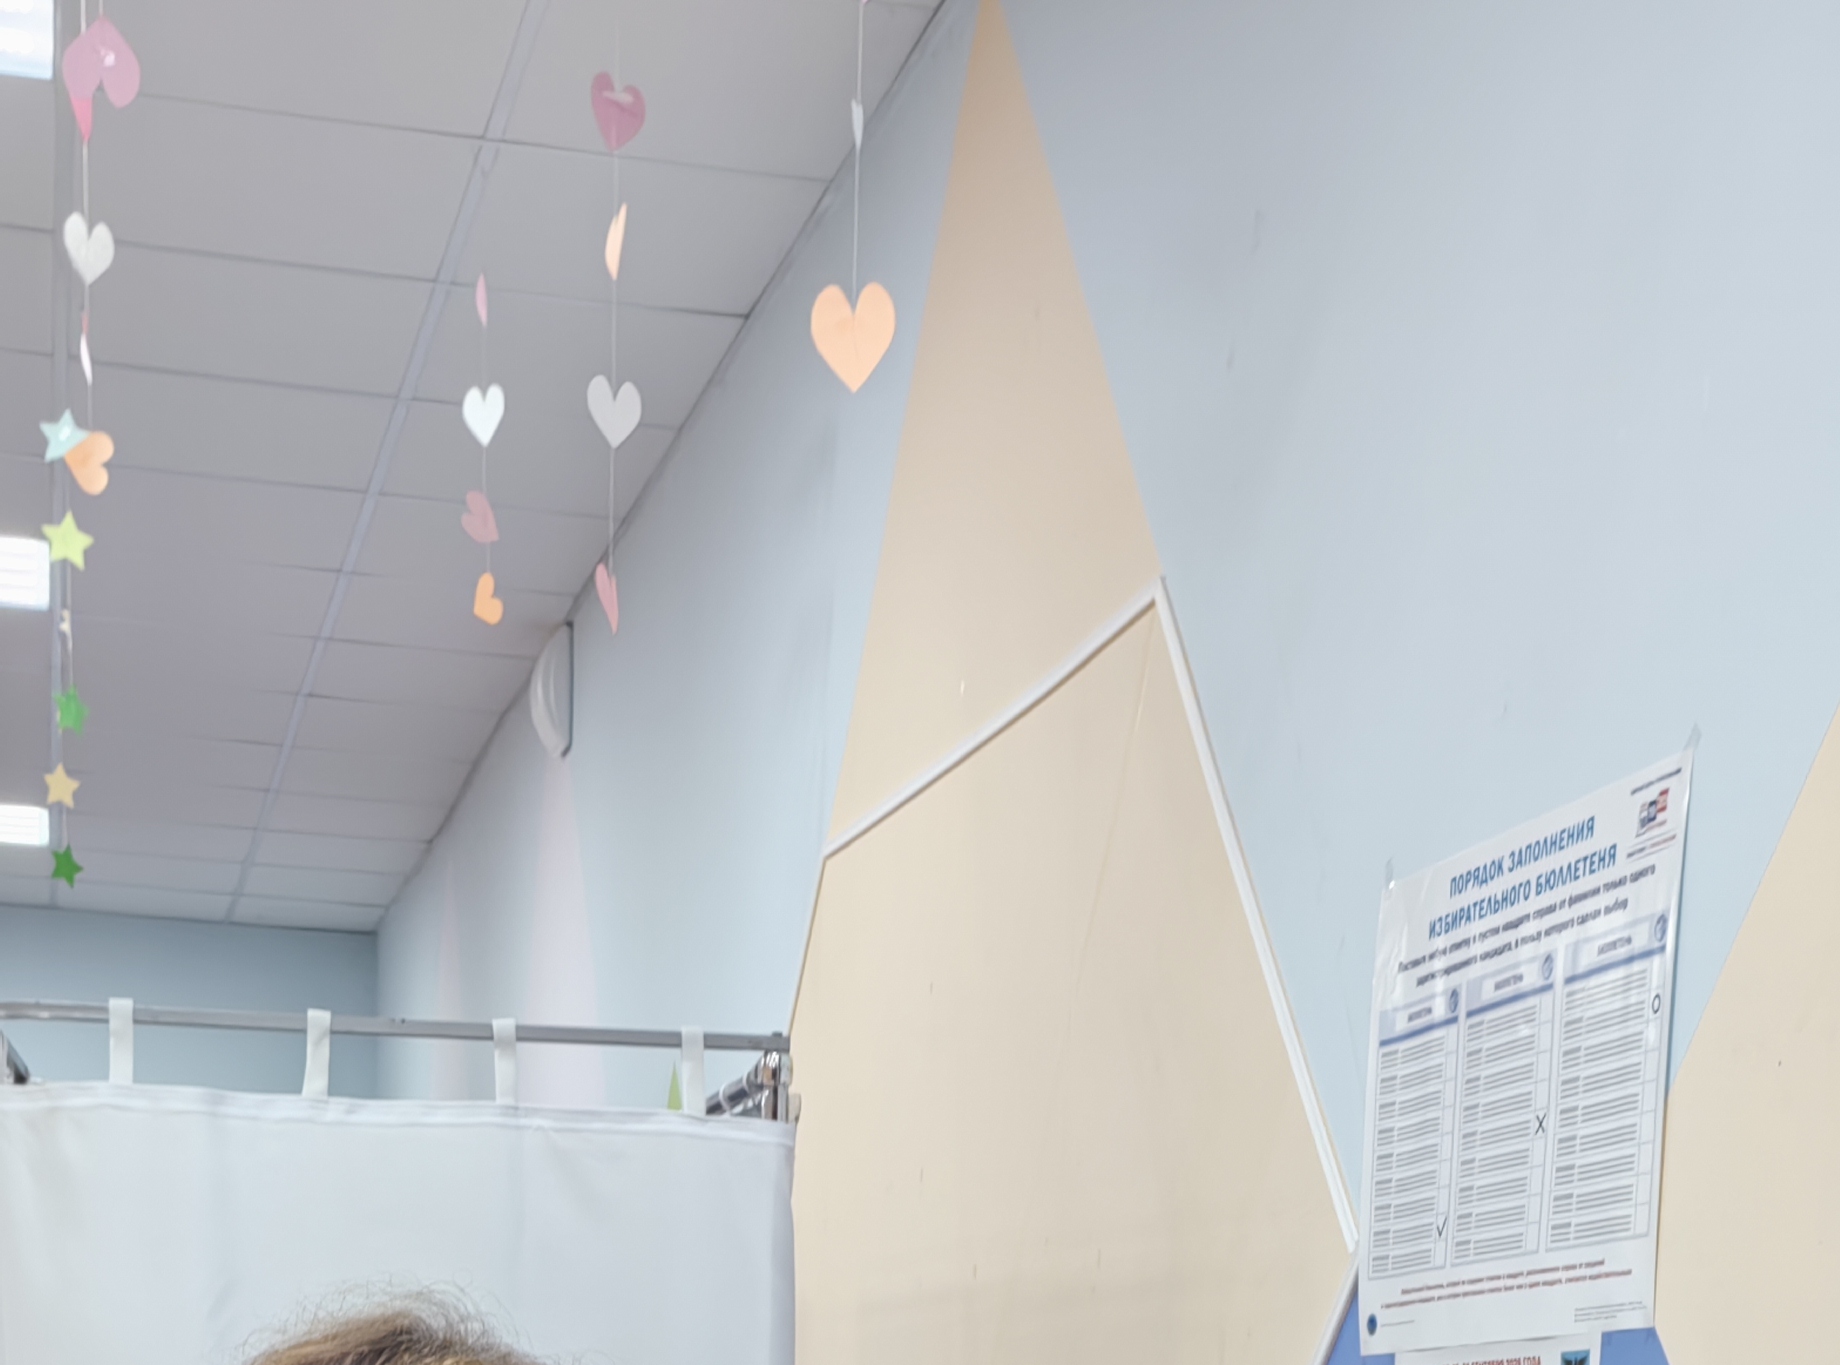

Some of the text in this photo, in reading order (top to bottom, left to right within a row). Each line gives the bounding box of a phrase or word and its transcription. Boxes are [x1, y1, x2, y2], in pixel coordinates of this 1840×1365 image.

[1429, 879, 1531, 940] ИЗБИРАТЕЛЬНОГО
[1535, 843, 1617, 896] БЮЛЛЕТЕНЯ
[1449, 855, 1505, 899] ПОРЯДОК
[1508, 815, 1595, 873] ЗАПОЛНЕНИЯ
